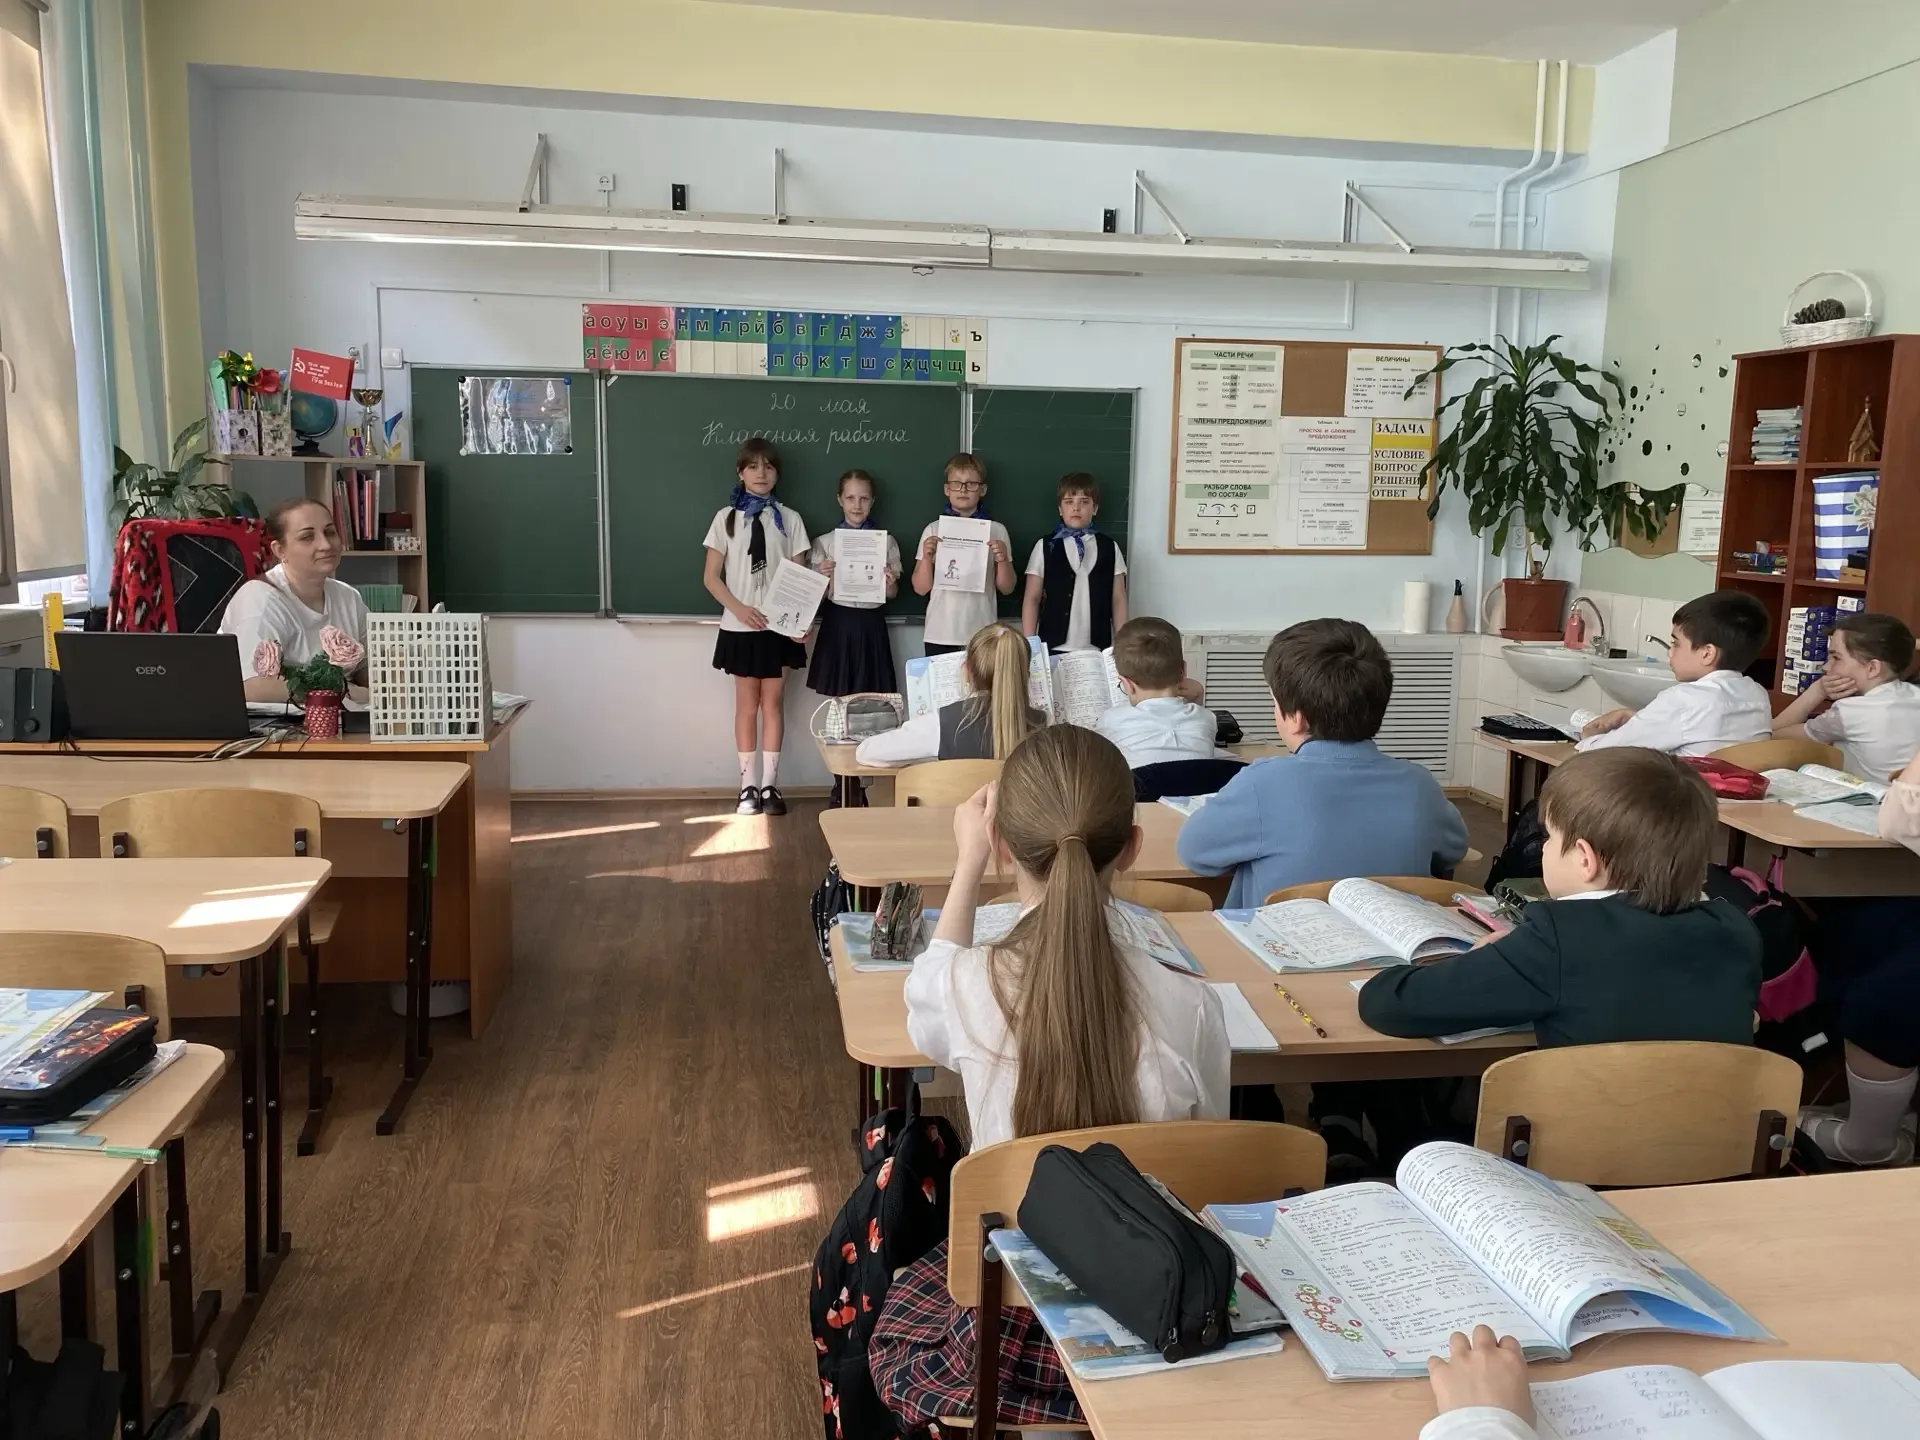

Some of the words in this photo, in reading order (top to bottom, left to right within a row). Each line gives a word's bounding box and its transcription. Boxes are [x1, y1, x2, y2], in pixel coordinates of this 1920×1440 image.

[585, 316, 596, 328] а
[600, 316, 611, 328] о
[616, 316, 627, 332] у
[634, 318, 648, 331] ы
[659, 319, 669, 330] э
[678, 319, 688, 331] н
[695, 319, 709, 332] м
[719, 320, 731, 333] л
[738, 321, 750, 336] р
[754, 319, 765, 334] й
[773, 319, 784, 335] б
[795, 324, 806, 336] в
[819, 325, 829, 336] г
[839, 325, 852, 340] д
[860, 326, 876, 339] ж
[884, 327, 895, 339] з
[970, 330, 982, 342] ъ
[586, 347, 597, 359] я
[601, 344, 612, 360] ё
[614, 348, 630, 361] ю
[636, 348, 647, 361] и
[658, 350, 669, 361] е
[773, 354, 784, 366] п
[793, 351, 809, 370] ф
[818, 356, 830, 368] к
[841, 357, 851, 369] т
[860, 357, 876, 370] ш
[884, 358, 895, 370] с
[904, 358, 914, 371] х
[917, 359, 929, 374] ц
[932, 360, 943, 371] ч
[948, 360, 964, 375] щ
[971, 362, 981, 372] ь
[1213, 351, 1235, 359] ЧАСТИ
[1236, 351, 1254, 359] РЕЧИ
[1375, 355, 1411, 363] ВЕЛИЧИНЫ
[770, 392, 796, 411] 20
[820, 398, 871, 414] мая
[1193, 417, 1217, 425] ЧЛЕНЫ
[1375, 422, 1425, 435] ЗАДАЧА
[702, 420, 820, 446] Классная
[825, 419, 911, 455] работа
[1374, 450, 1425, 460] УСЛОВИЕ
[1374, 463, 1418, 472] ВОПРОС
[1373, 475, 1421, 485] РЕШЕНИ
[1372, 488, 1408, 498] ОТВЕТ
[135, 664, 167, 675] DEPO
